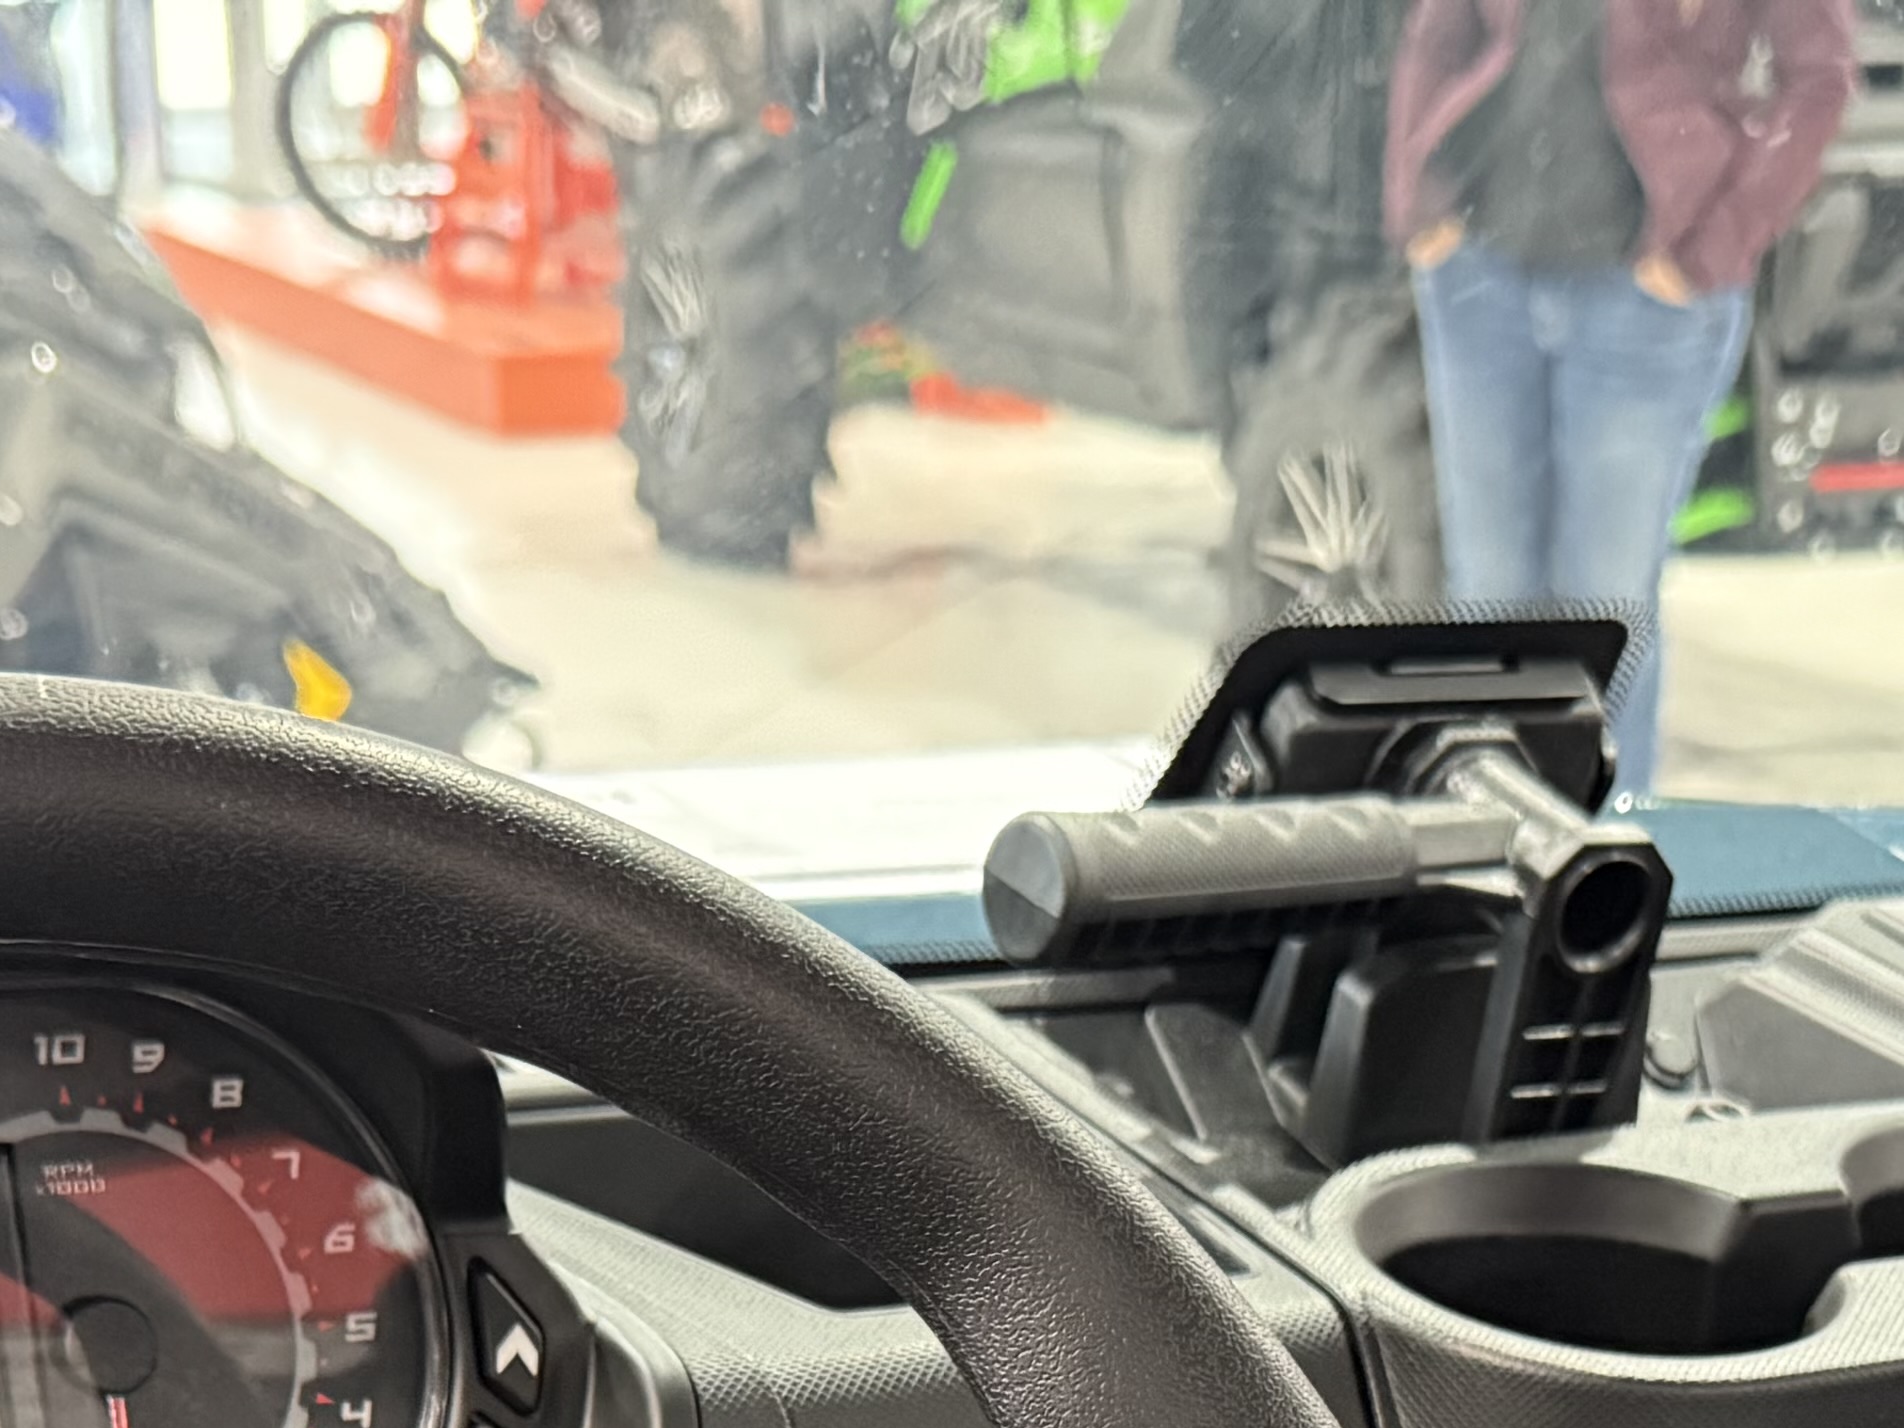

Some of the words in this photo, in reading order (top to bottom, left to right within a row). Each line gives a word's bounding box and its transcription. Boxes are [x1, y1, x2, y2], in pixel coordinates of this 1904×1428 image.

[34, 1033, 85, 1065] 10
[131, 1041, 165, 1073] 9
[211, 1077, 244, 1109] 8
[42, 1162, 94, 1179] RPM
[272, 1151, 300, 1180] 7
[323, 1223, 356, 1254] 6
[345, 1311, 377, 1343] 5
